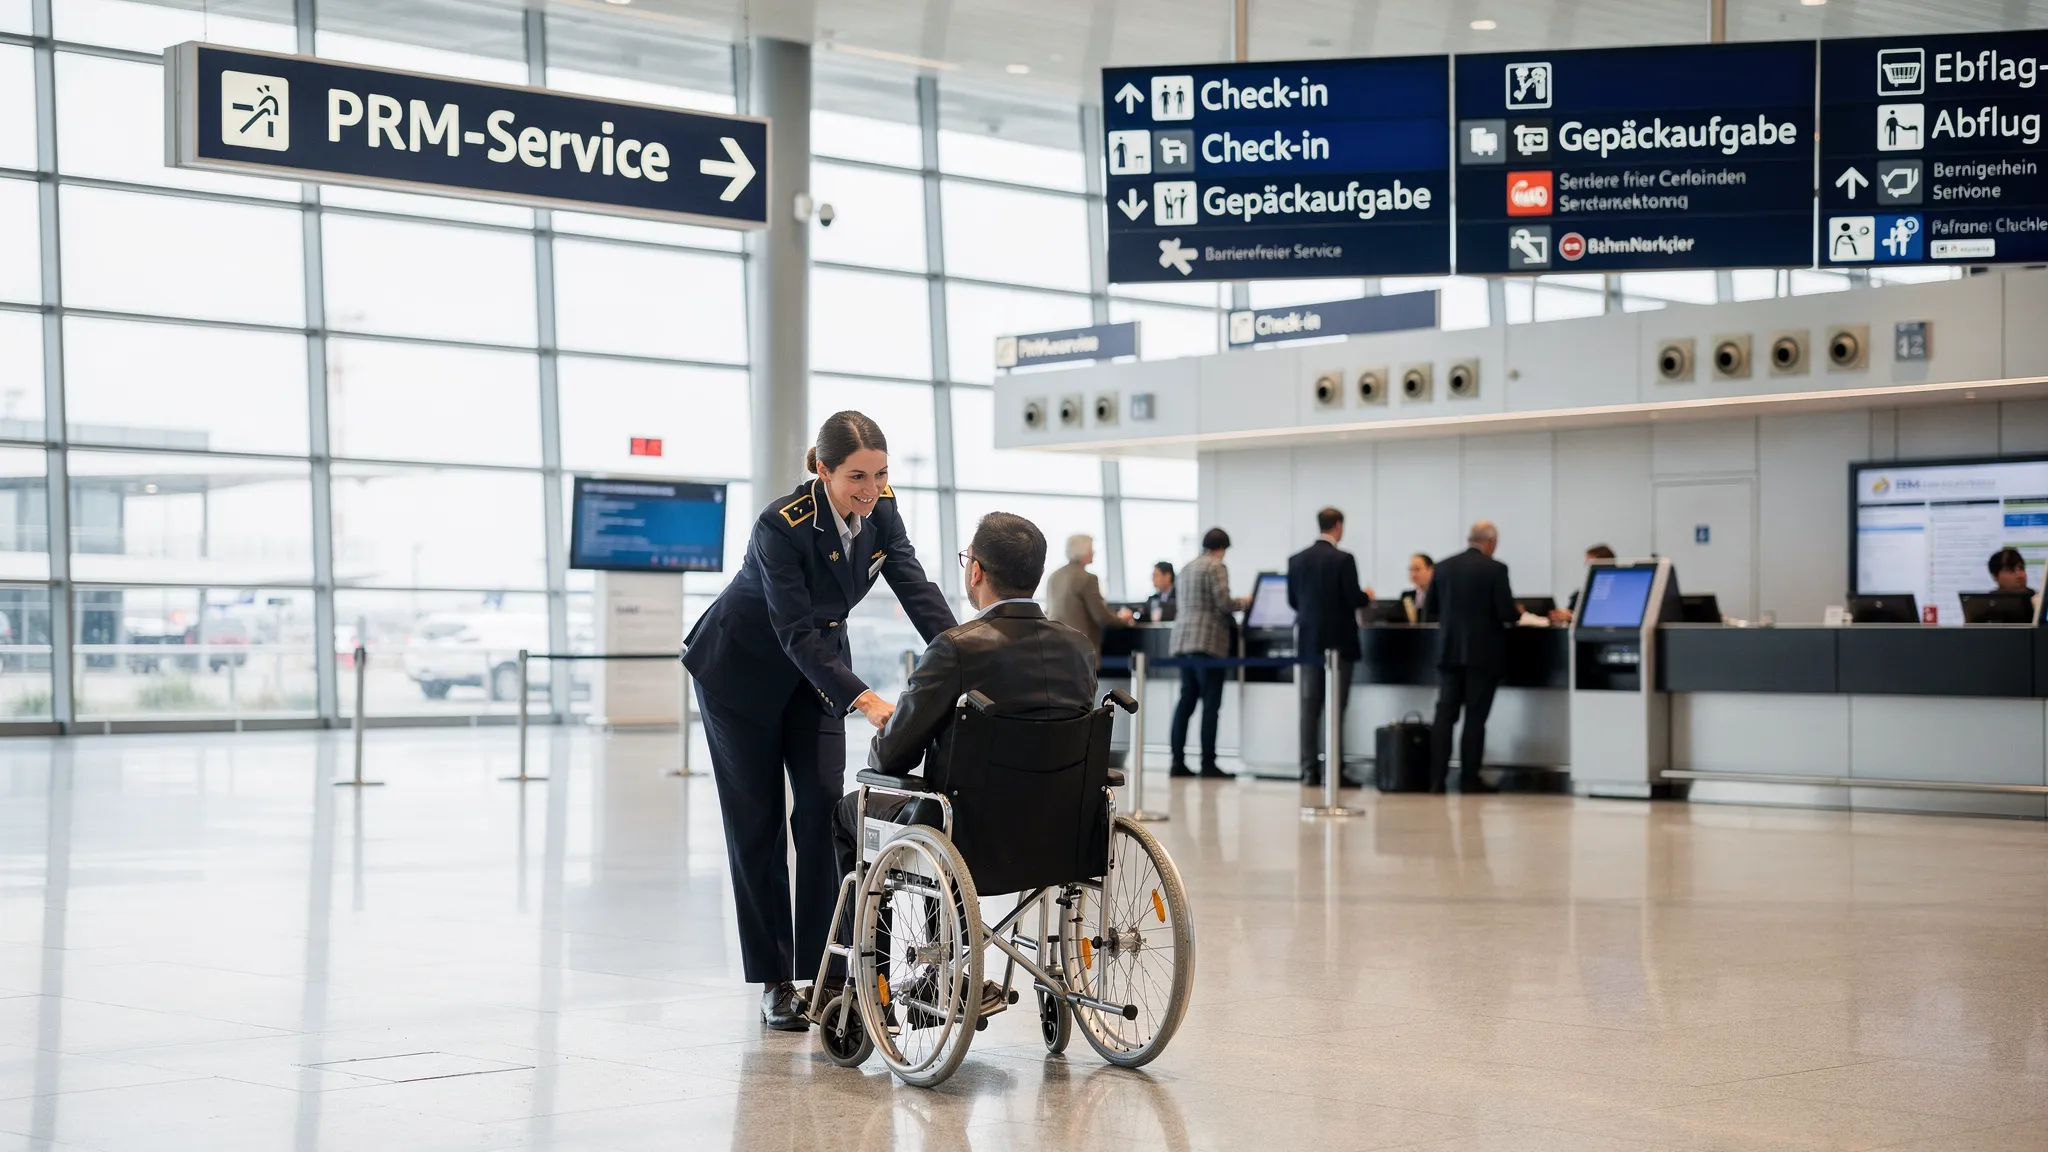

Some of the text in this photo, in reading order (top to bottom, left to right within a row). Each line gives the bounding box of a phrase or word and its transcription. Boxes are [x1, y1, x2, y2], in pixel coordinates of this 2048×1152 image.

[1201, 76, 1328, 111] Check-in
[327, 88, 671, 183] PRM-Service
[1558, 114, 1797, 158] Gepäckaufgabe
[1931, 105, 2041, 145] Abflug
[1202, 130, 1330, 164] Check-in
[1203, 179, 1431, 222] Gepäckaufgabe
[1293, 242, 1342, 259] Service
